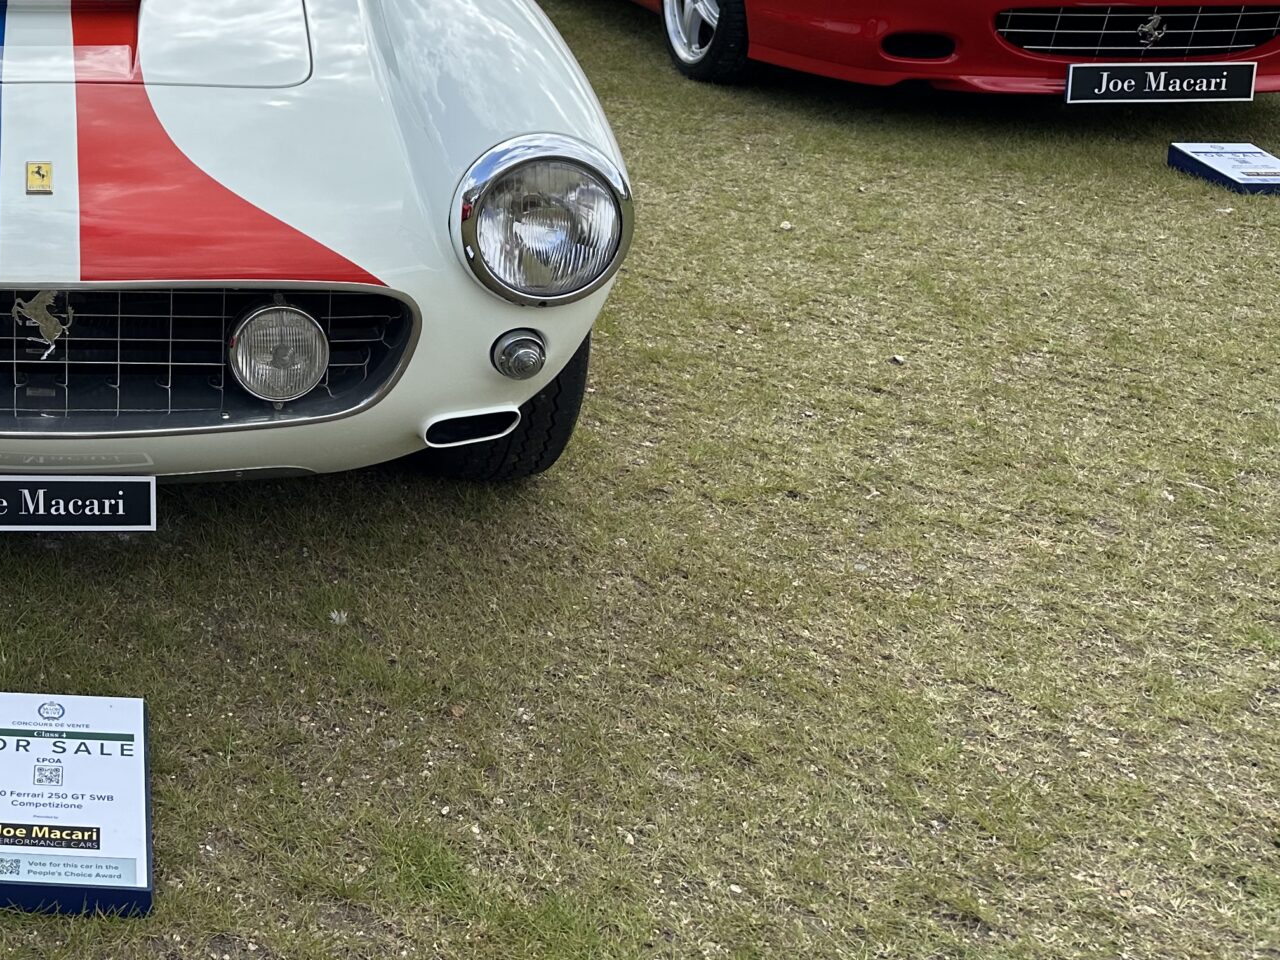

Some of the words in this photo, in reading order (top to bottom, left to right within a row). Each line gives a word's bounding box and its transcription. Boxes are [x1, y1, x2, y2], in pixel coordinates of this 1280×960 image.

[1094, 72, 1136, 95] Joe
[1143, 71, 1228, 92] Macari
[18, 488, 126, 516] Macari
[34, 730, 60, 738] Class
[52, 740, 134, 756] SALE
[47, 792, 68, 800] 250
[89, 794, 114, 802] SWB
[10, 800, 83, 810] Competizione
[32, 826, 97, 840] Macari
[27, 869, 62, 877] People's
